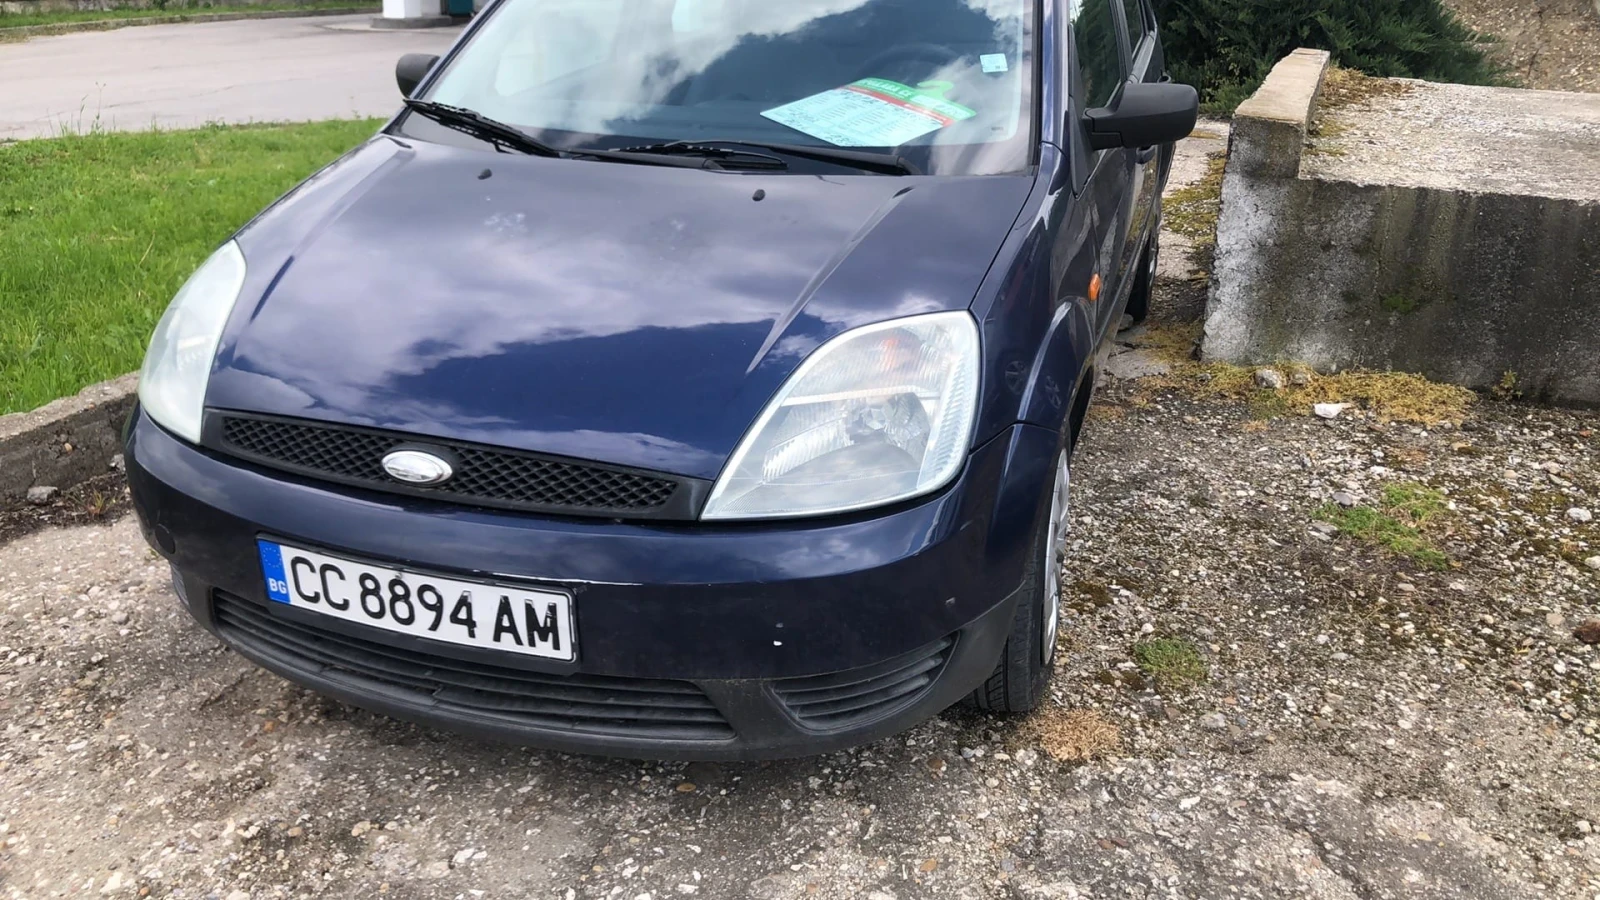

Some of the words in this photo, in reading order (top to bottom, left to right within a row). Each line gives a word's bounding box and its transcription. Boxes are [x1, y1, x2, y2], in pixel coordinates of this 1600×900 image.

[269, 577, 287, 595] BG
[359, 572, 477, 638] 8894
[493, 595, 561, 650] AM
